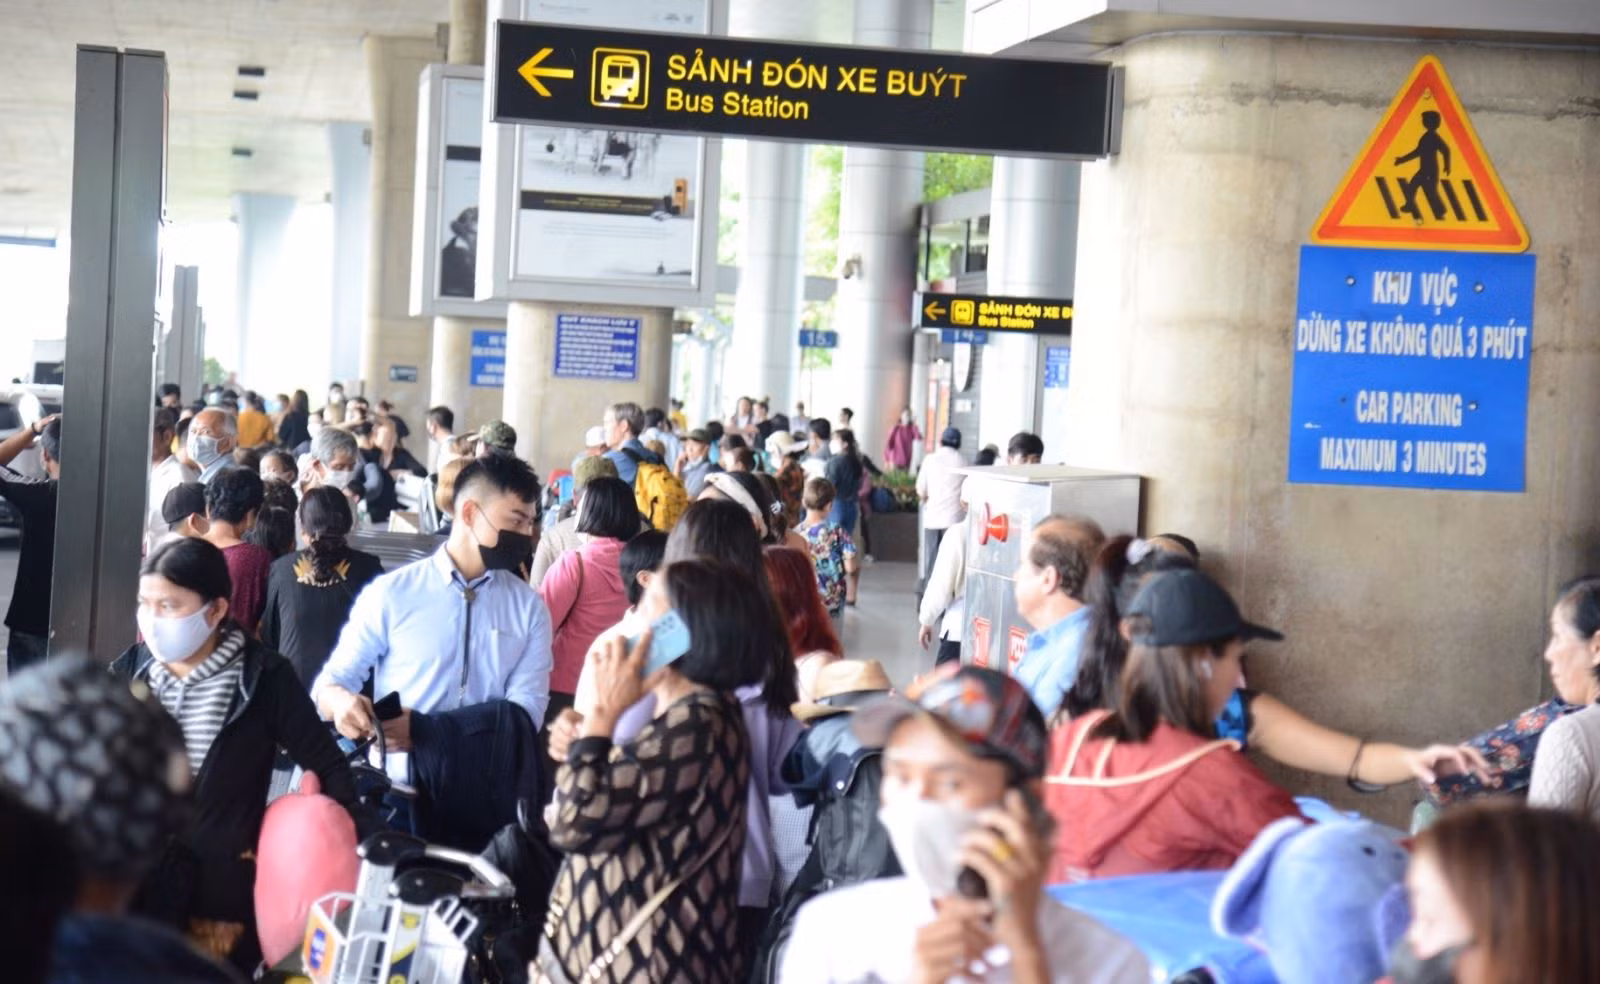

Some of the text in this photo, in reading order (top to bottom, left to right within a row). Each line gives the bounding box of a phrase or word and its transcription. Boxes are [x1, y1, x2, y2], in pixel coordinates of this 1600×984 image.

[667, 48, 967, 98] SẢNH ĐÓN XE BUÝT
[666, 88, 809, 120] Bus Station
[1372, 267, 1458, 315] KHU VỰC
[978, 315, 998, 327] Bus
[1043, 306, 1060, 319] XE
[1297, 311, 1527, 360] DỪNG XE KHÔNG QUÁ 3 PHÚT
[1356, 390, 1462, 427] CAR PARKING
[1320, 437, 1486, 476] MAXIMUM 3 MINUTES
